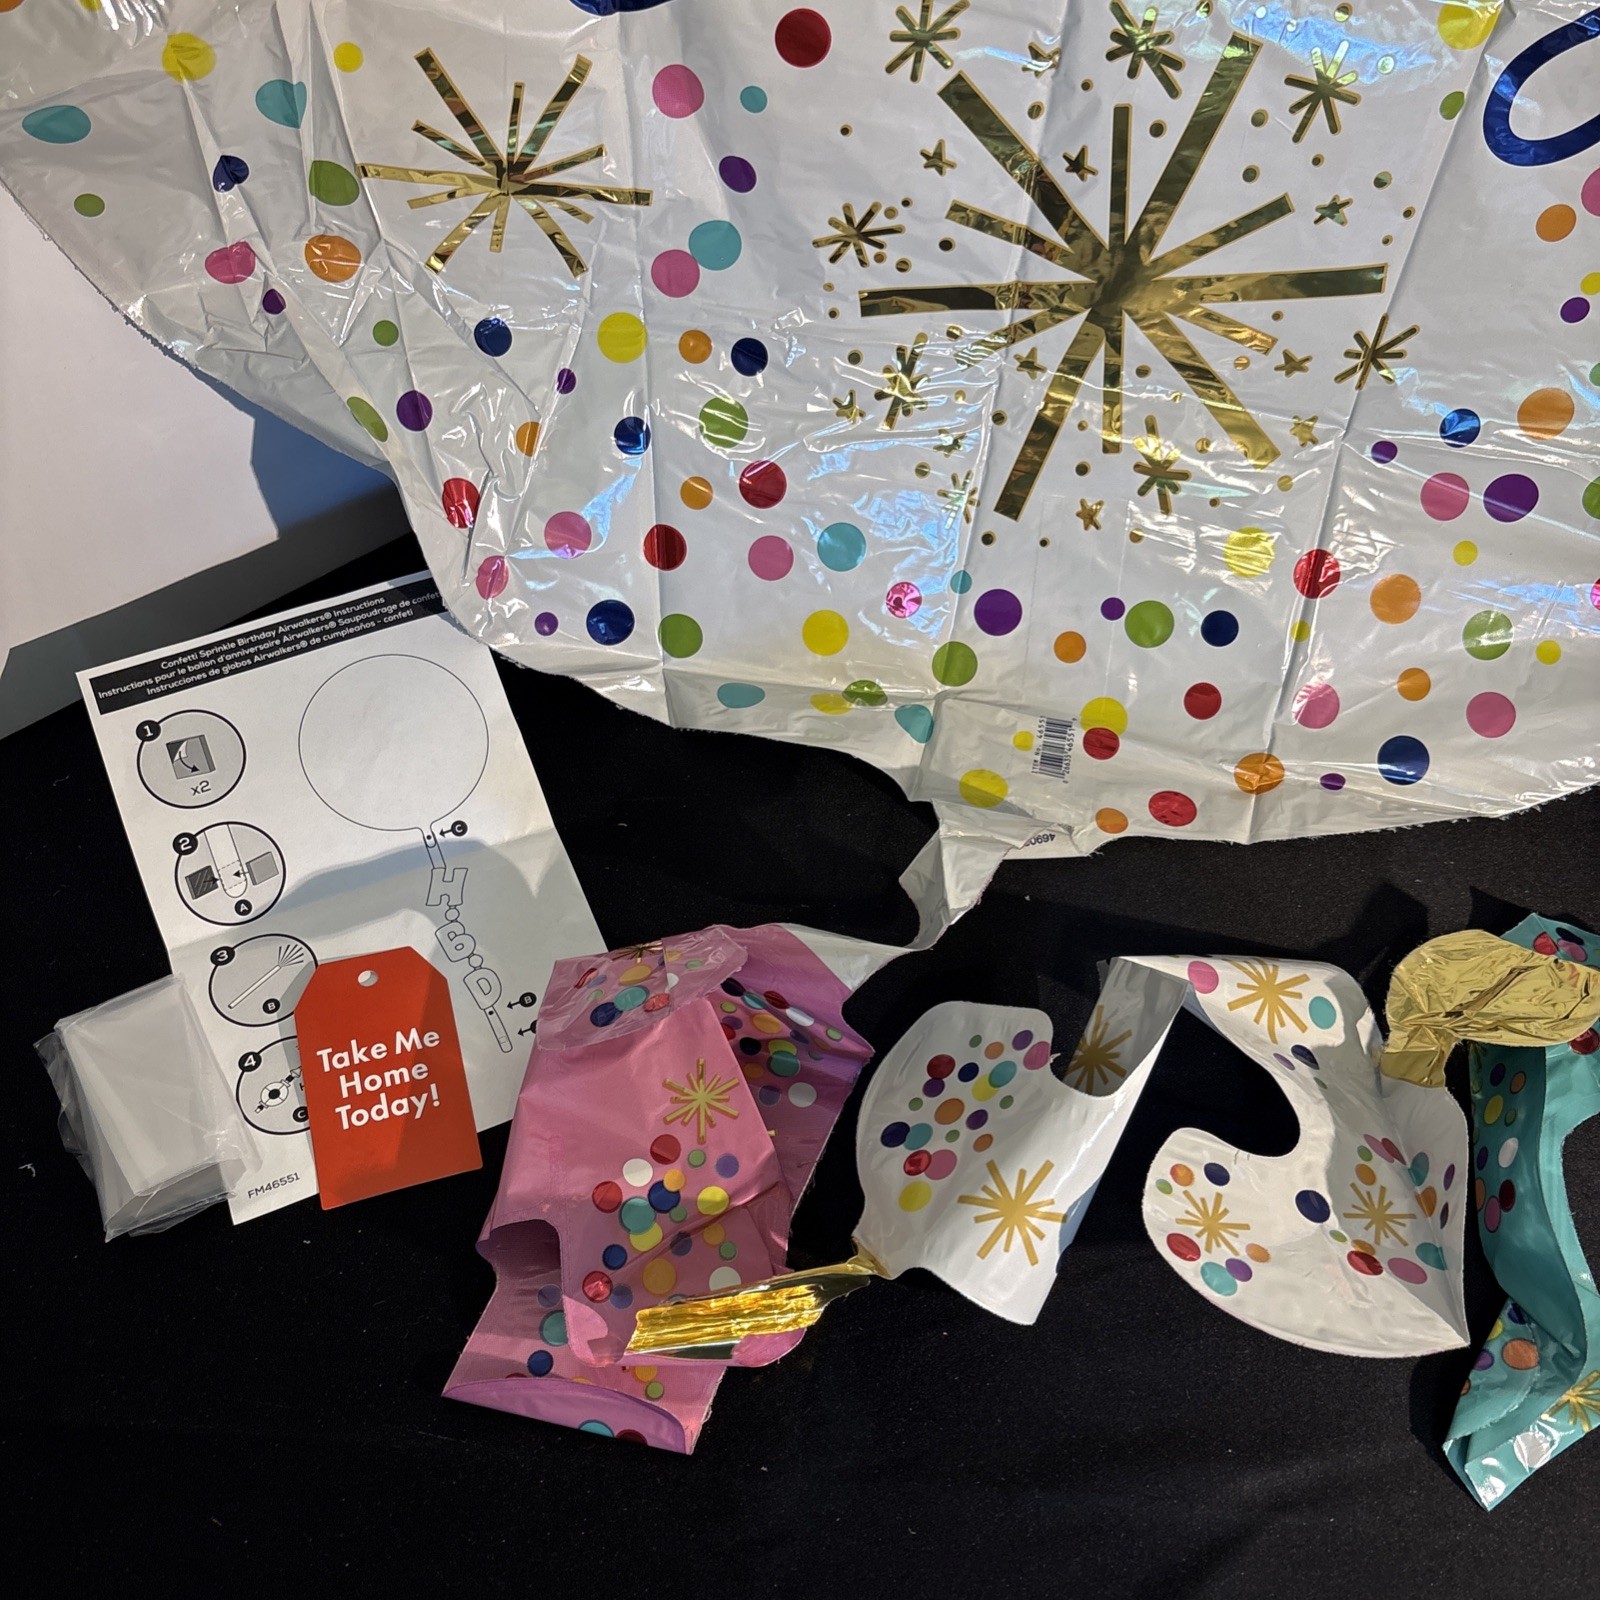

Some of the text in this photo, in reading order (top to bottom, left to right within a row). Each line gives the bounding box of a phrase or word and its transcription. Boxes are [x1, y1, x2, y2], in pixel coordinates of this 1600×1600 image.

[98, 678, 154, 699] Instructions
[155, 670, 176, 684] pour
[177, 667, 187, 676] le
[187, 657, 217, 673] ballon
[217, 638, 281, 663] d'anniversaire
[338, 604, 398, 626] Saupoudrage
[399, 599, 411, 608] de
[412, 591, 440, 605] confet
[147, 671, 208, 695] Instrucciones
[208, 667, 220, 677] de
[221, 658, 252, 674] globos
[309, 637, 322, 646] de
[322, 620, 376, 641] cumpleaños
[383, 608, 414, 623] confeti
[161, 653, 198, 670] Confetti
[199, 641, 236, 658] Sprinkle
[238, 629, 276, 646] Birthday
[333, 597, 385, 617] Instructions
[190, 779, 212, 797] x2
[316, 1027, 441, 1073] Take Me
[339, 1061, 429, 1099] Home
[335, 1083, 441, 1130] Today!
[247, 1171, 301, 1199] FM46551
